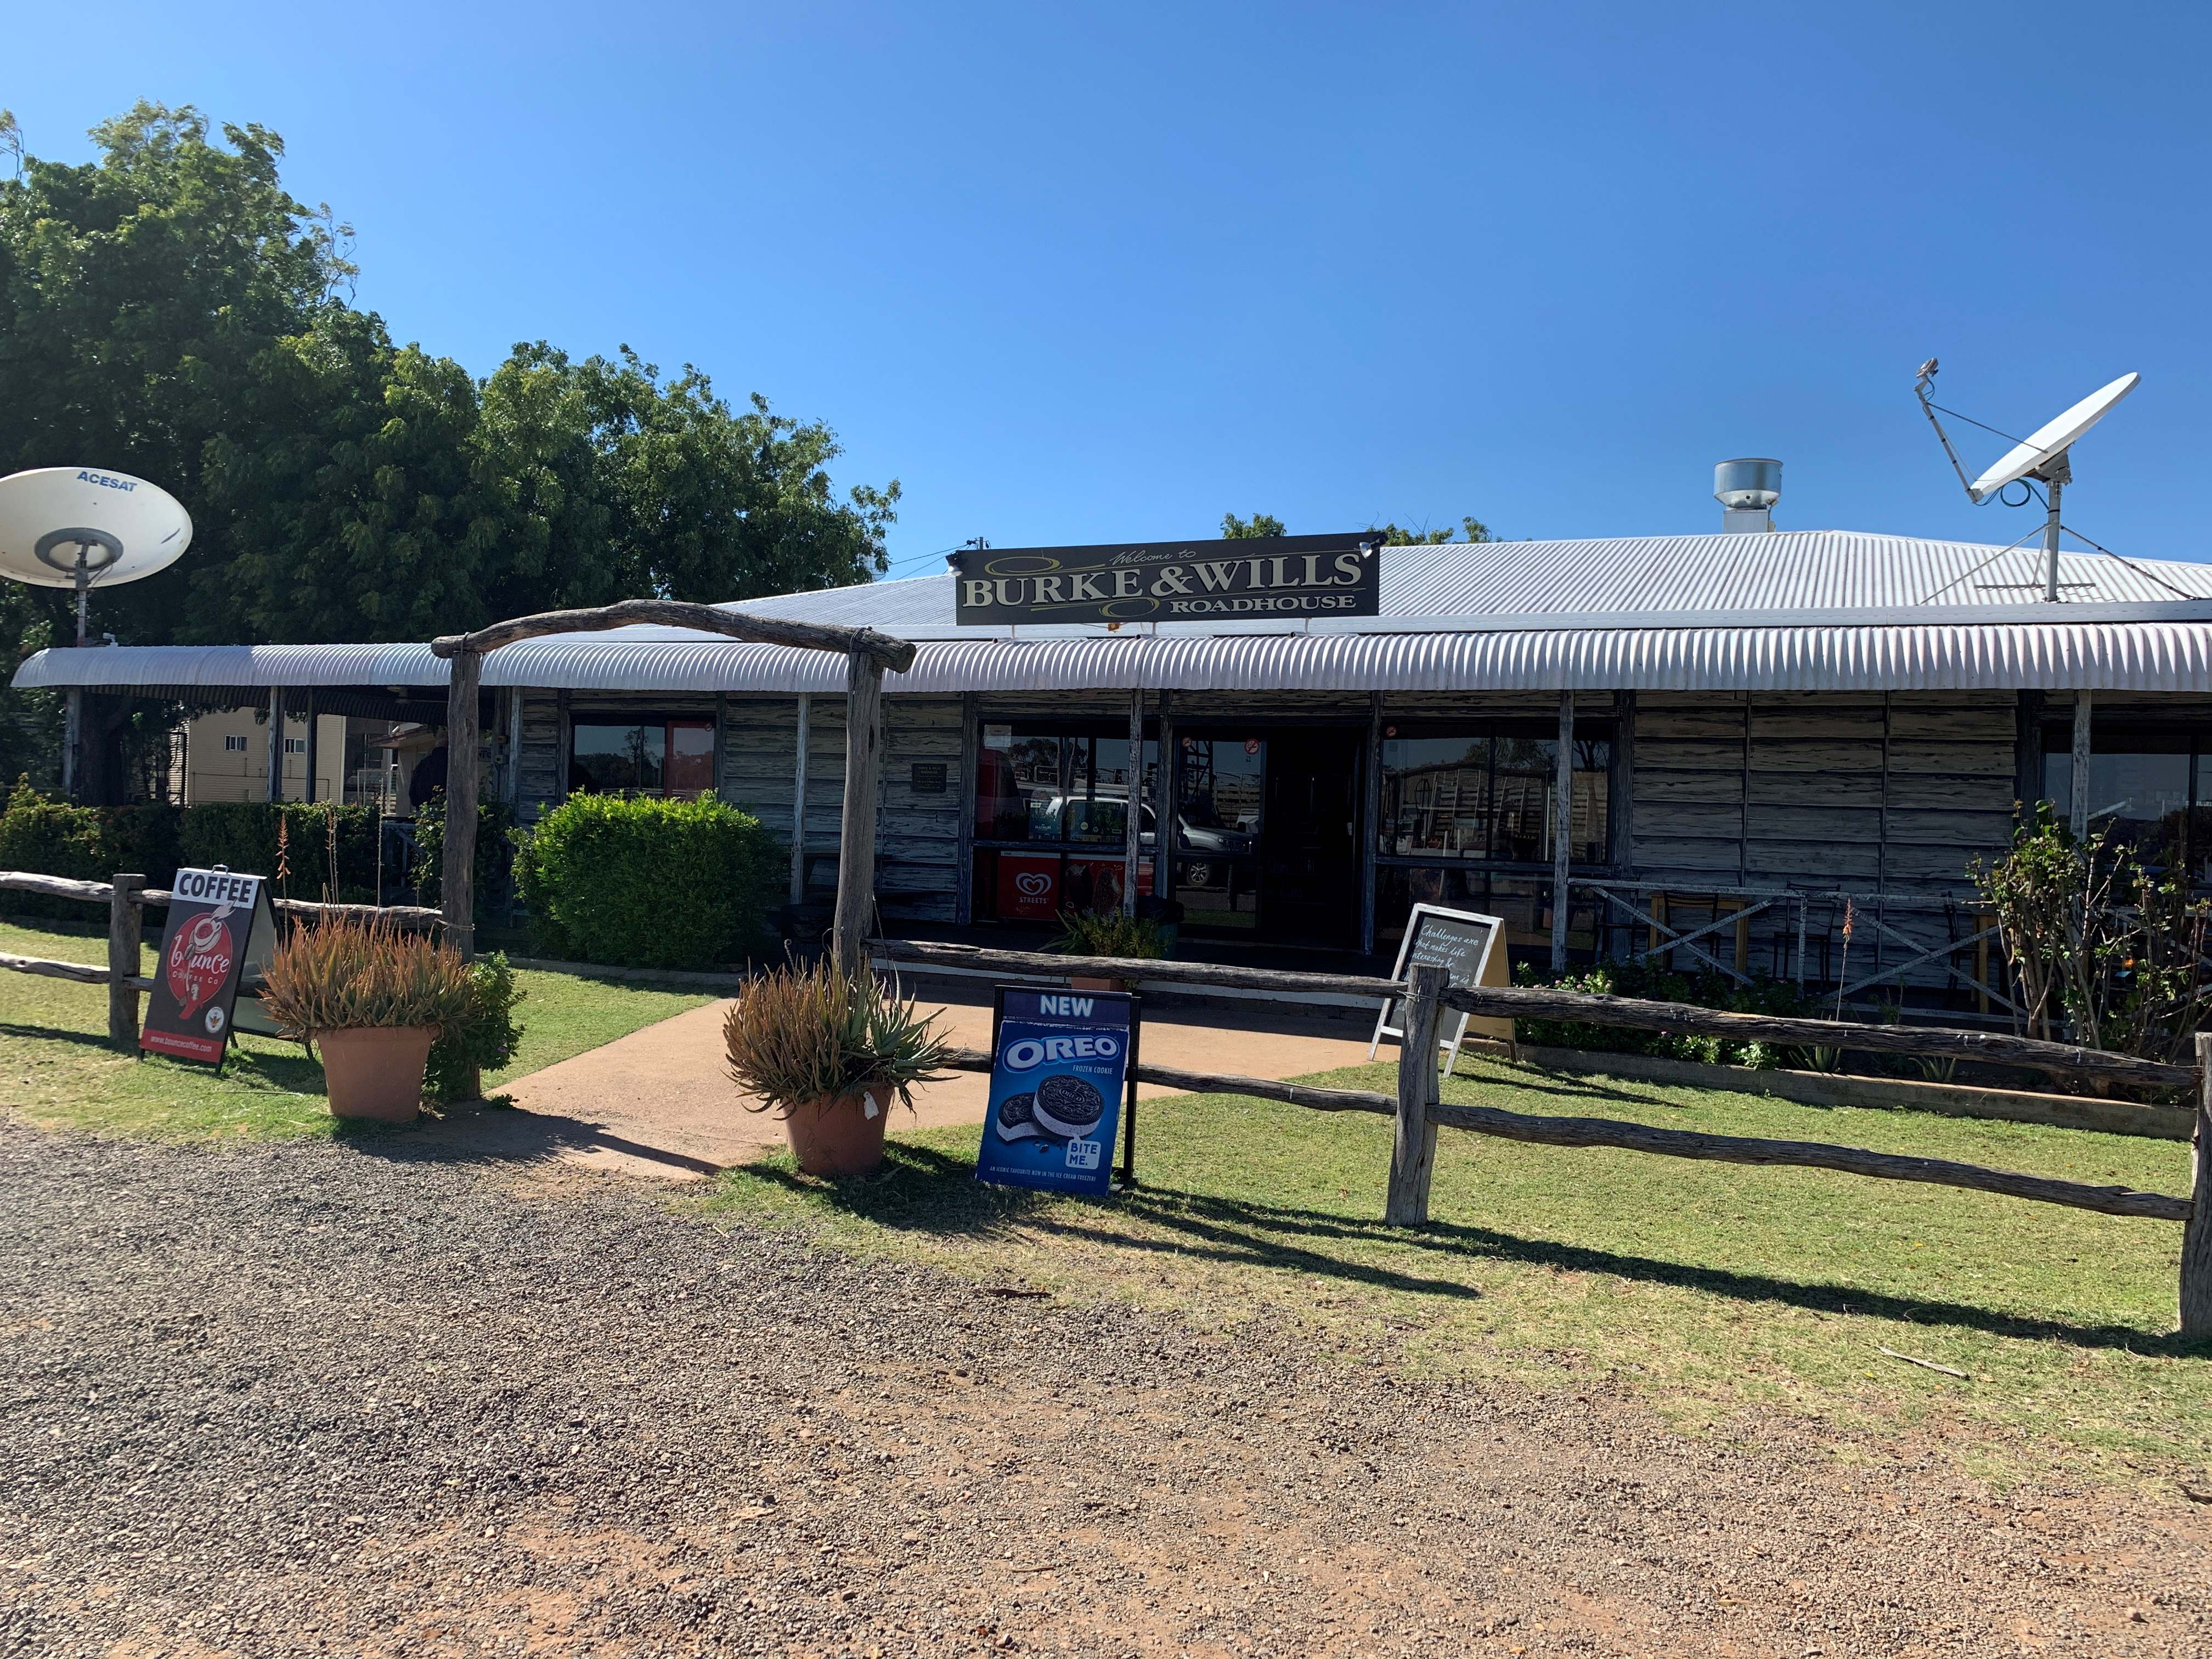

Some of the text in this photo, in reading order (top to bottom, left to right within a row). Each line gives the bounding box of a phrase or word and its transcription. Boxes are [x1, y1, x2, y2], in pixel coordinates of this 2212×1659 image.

[76, 471, 138, 492] ACESAT
[1109, 549, 1197, 565] Welcome to
[962, 568, 1142, 607] BURKE
[1169, 594, 1357, 614] ROADHOUSE
[178, 873, 253, 903] COFFEE
[1421, 924, 1479, 947] Challenges are
[1430, 944, 1449, 953] makes
[1449, 947, 1466, 957] life
[1445, 957, 1454, 970] &
[1040, 995, 1093, 1017] NEW
[150, 1035, 212, 1053] www.bouncecoffee.com
[1006, 1037, 1117, 1069] OREO
[1073, 1064, 1113, 1075] FROZEN COOKIE
[1062, 1090, 1082, 1102] OREO
[1070, 1142, 1097, 1155] BITE
[1069, 1154, 1088, 1166] ME.
[1010, 1167, 1030, 1176] FAVOURITE
